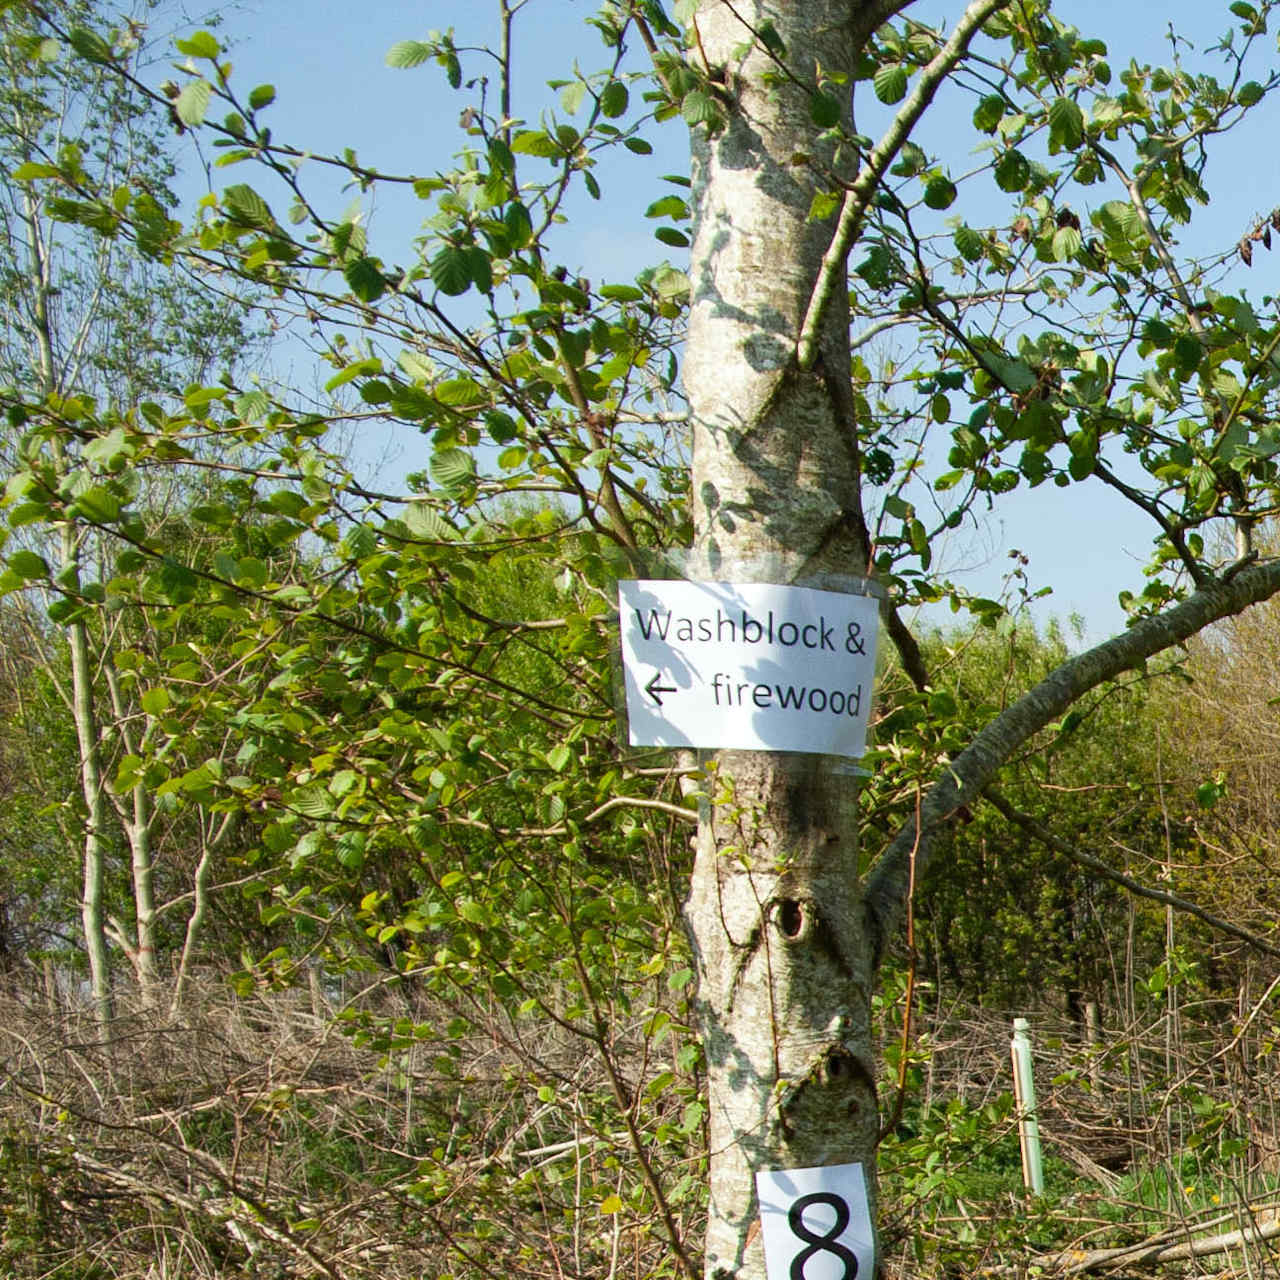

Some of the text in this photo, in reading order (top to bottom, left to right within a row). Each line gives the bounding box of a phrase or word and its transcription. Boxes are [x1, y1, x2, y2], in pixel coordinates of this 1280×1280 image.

[635, 609, 867, 656] Washblock &
[711, 673, 862, 717] firewood
